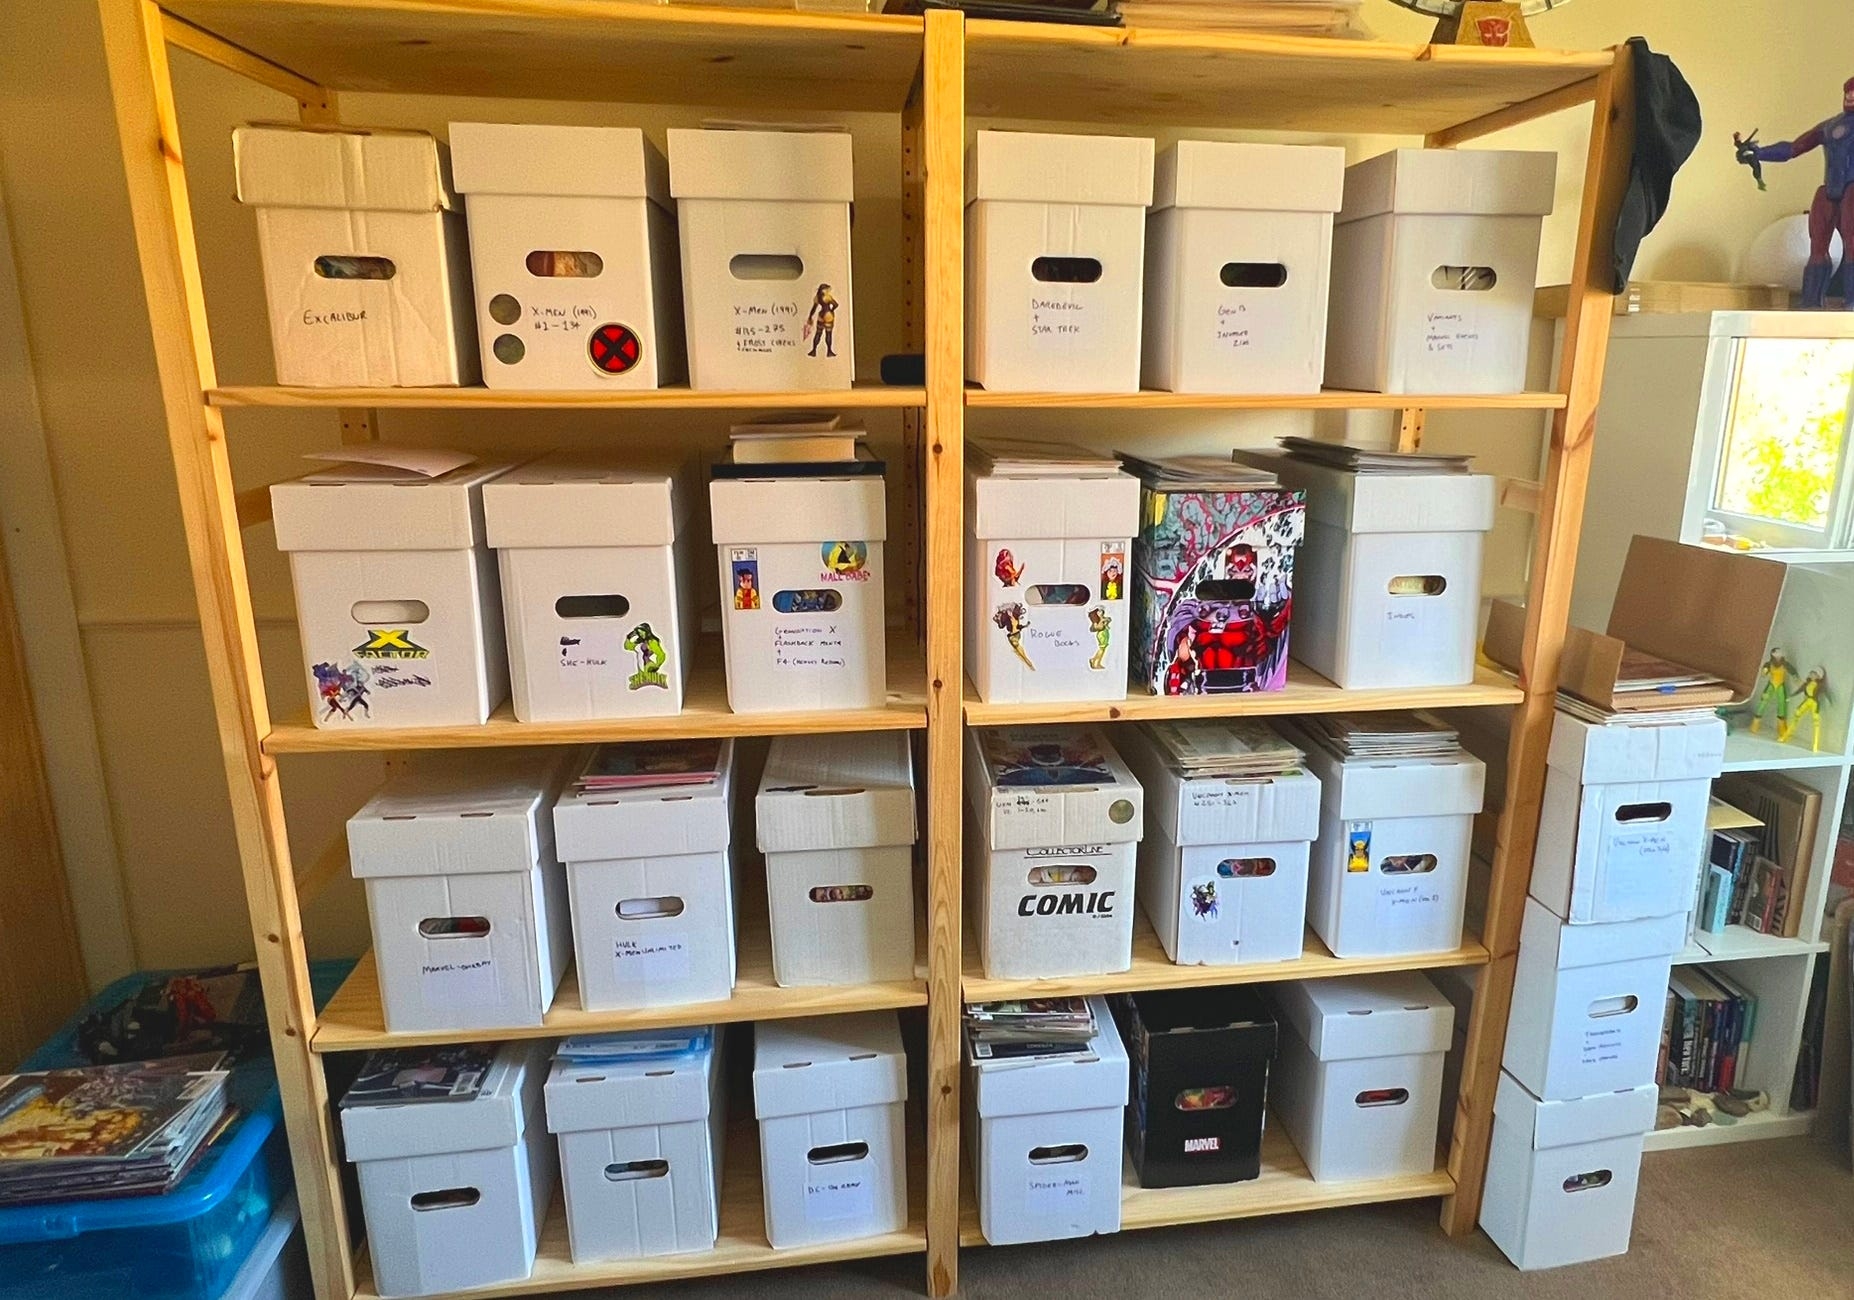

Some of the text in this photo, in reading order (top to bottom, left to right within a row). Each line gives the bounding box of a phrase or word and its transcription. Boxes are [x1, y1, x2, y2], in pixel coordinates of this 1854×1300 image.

[829, 625, 837, 634] X
[1018, 891, 1116, 917] COMIC
[1184, 1137, 1219, 1152] MARVEL
